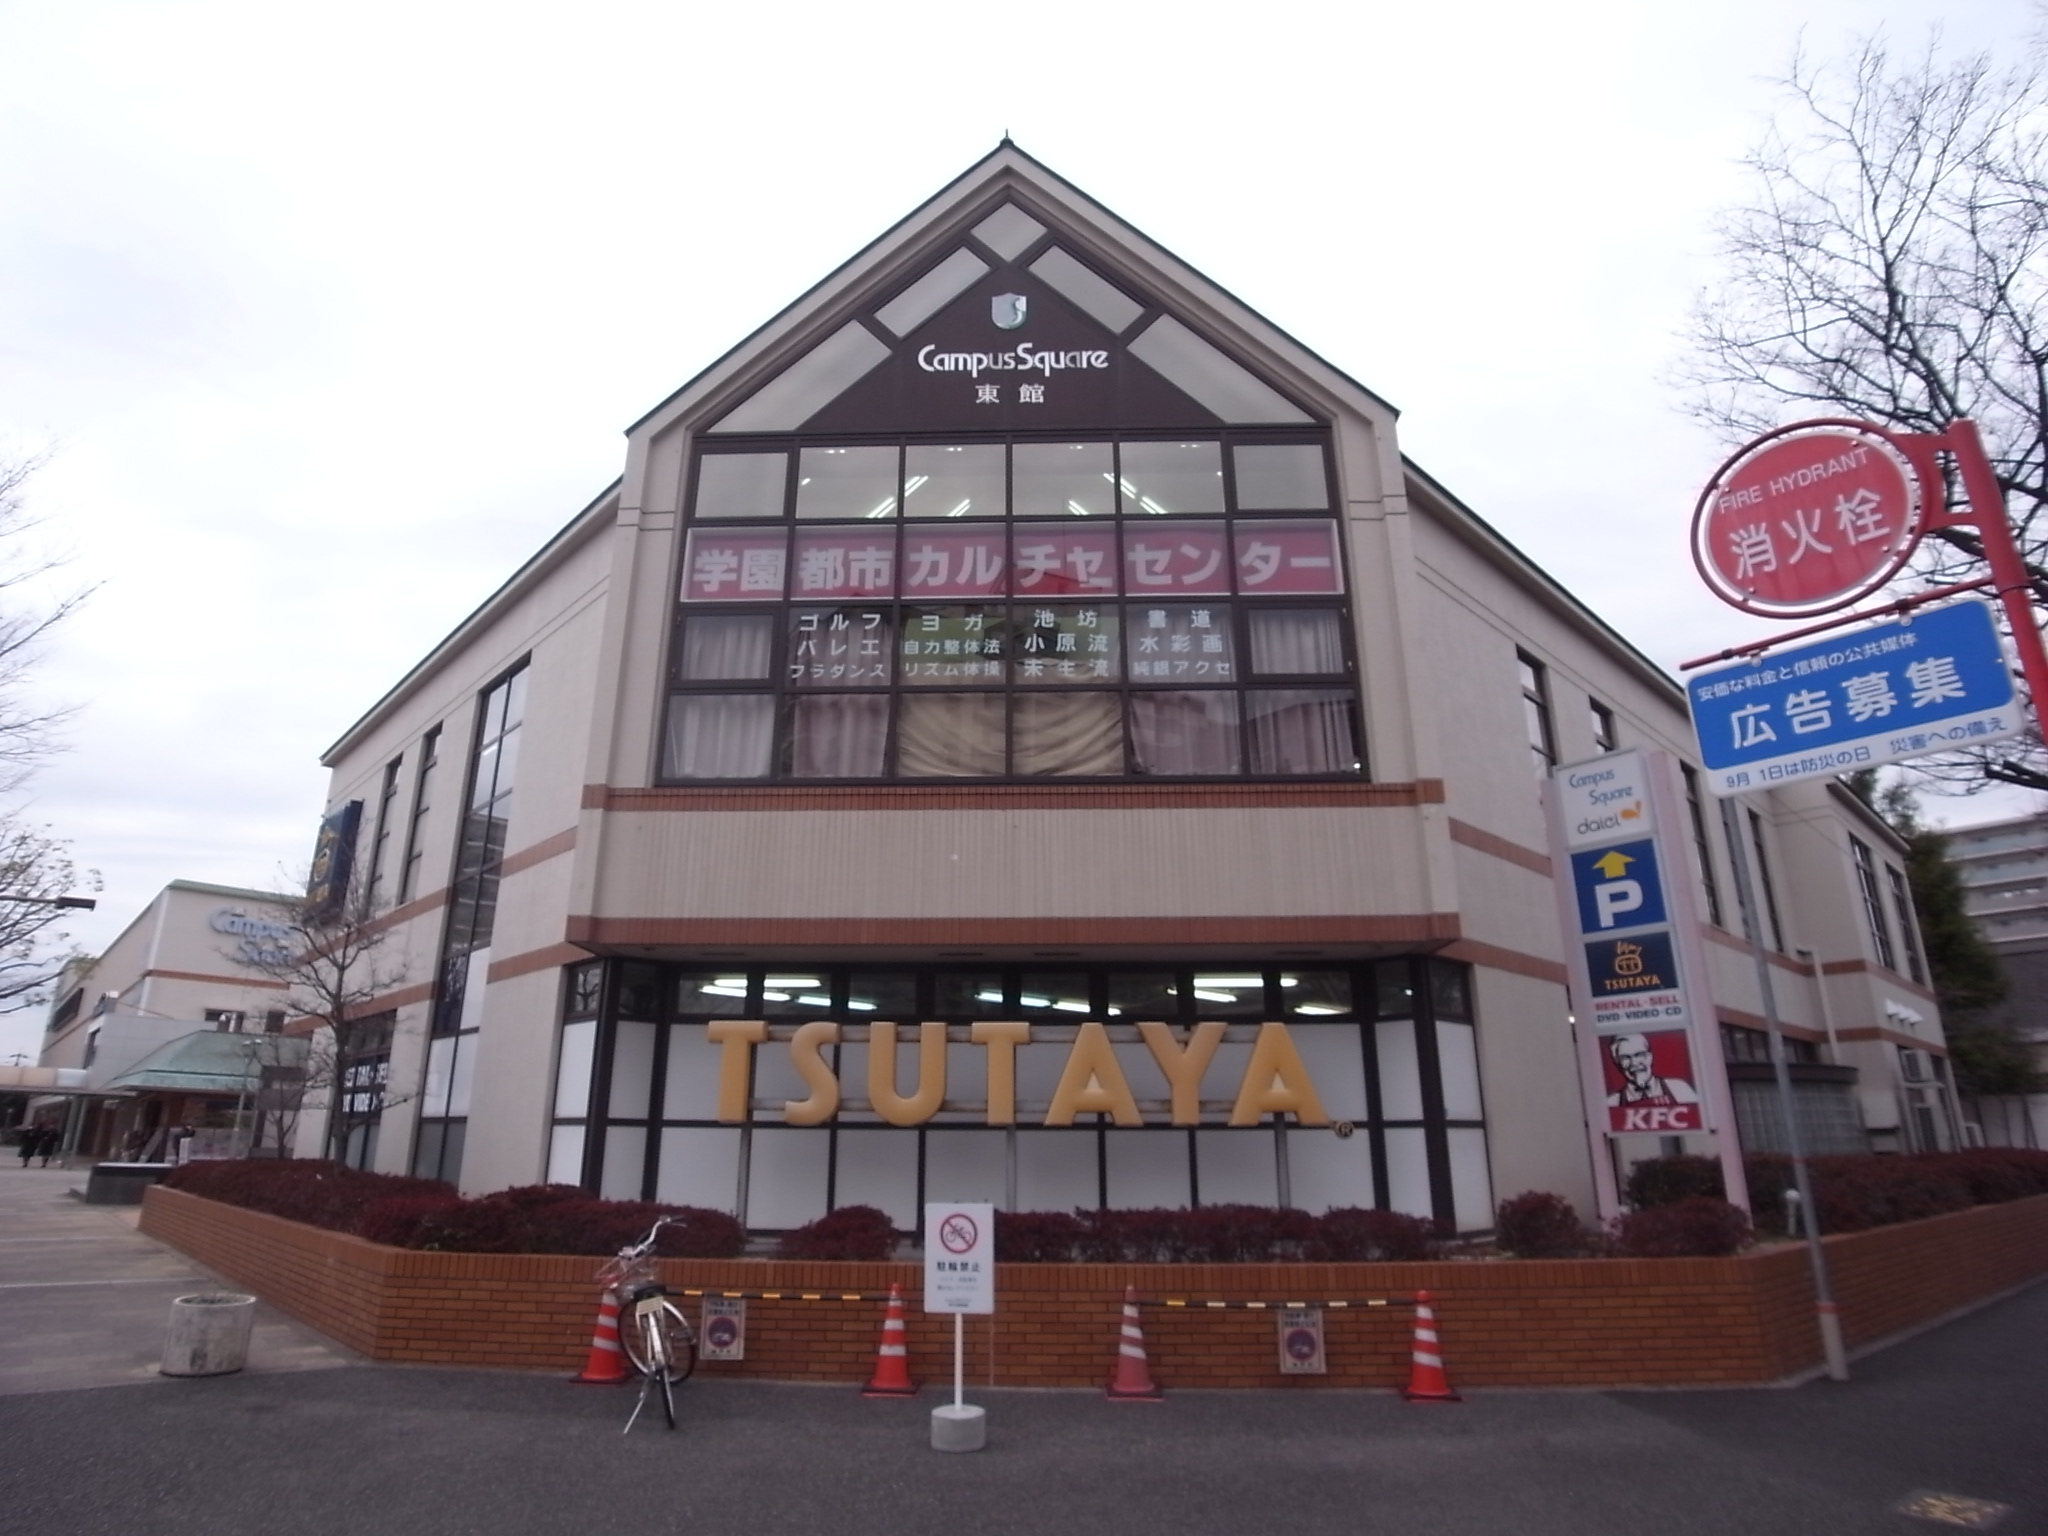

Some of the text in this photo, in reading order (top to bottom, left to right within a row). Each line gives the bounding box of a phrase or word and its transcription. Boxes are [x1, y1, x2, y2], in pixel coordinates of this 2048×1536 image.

[975, 383, 1045, 404] 東館
[1719, 447, 1868, 514] FIRE HYDRANT
[1730, 488, 1890, 579] 消火栓
[800, 613, 881, 631] ゴルフ
[921, 613, 983, 631] ヨガ
[1034, 608, 1097, 628] 池坊
[797, 639, 879, 656] バレエ
[1024, 633, 1108, 652] 小原流
[1140, 634, 1222, 653] 水彩画
[790, 663, 885, 678] フラダンス
[1731, 657, 1966, 749] 広告募集
[1569, 769, 1615, 788] Campus
[1589, 786, 1633, 806] Square
[1595, 879, 1643, 928] P
[1604, 974, 1661, 990] TSUTAYA
[1625, 1009, 1659, 1020] VIDEO
[1665, 1006, 1682, 1016] CD
[708, 1020, 1330, 1127] TSUTAYA
[1624, 1106, 1688, 1131] KFC
